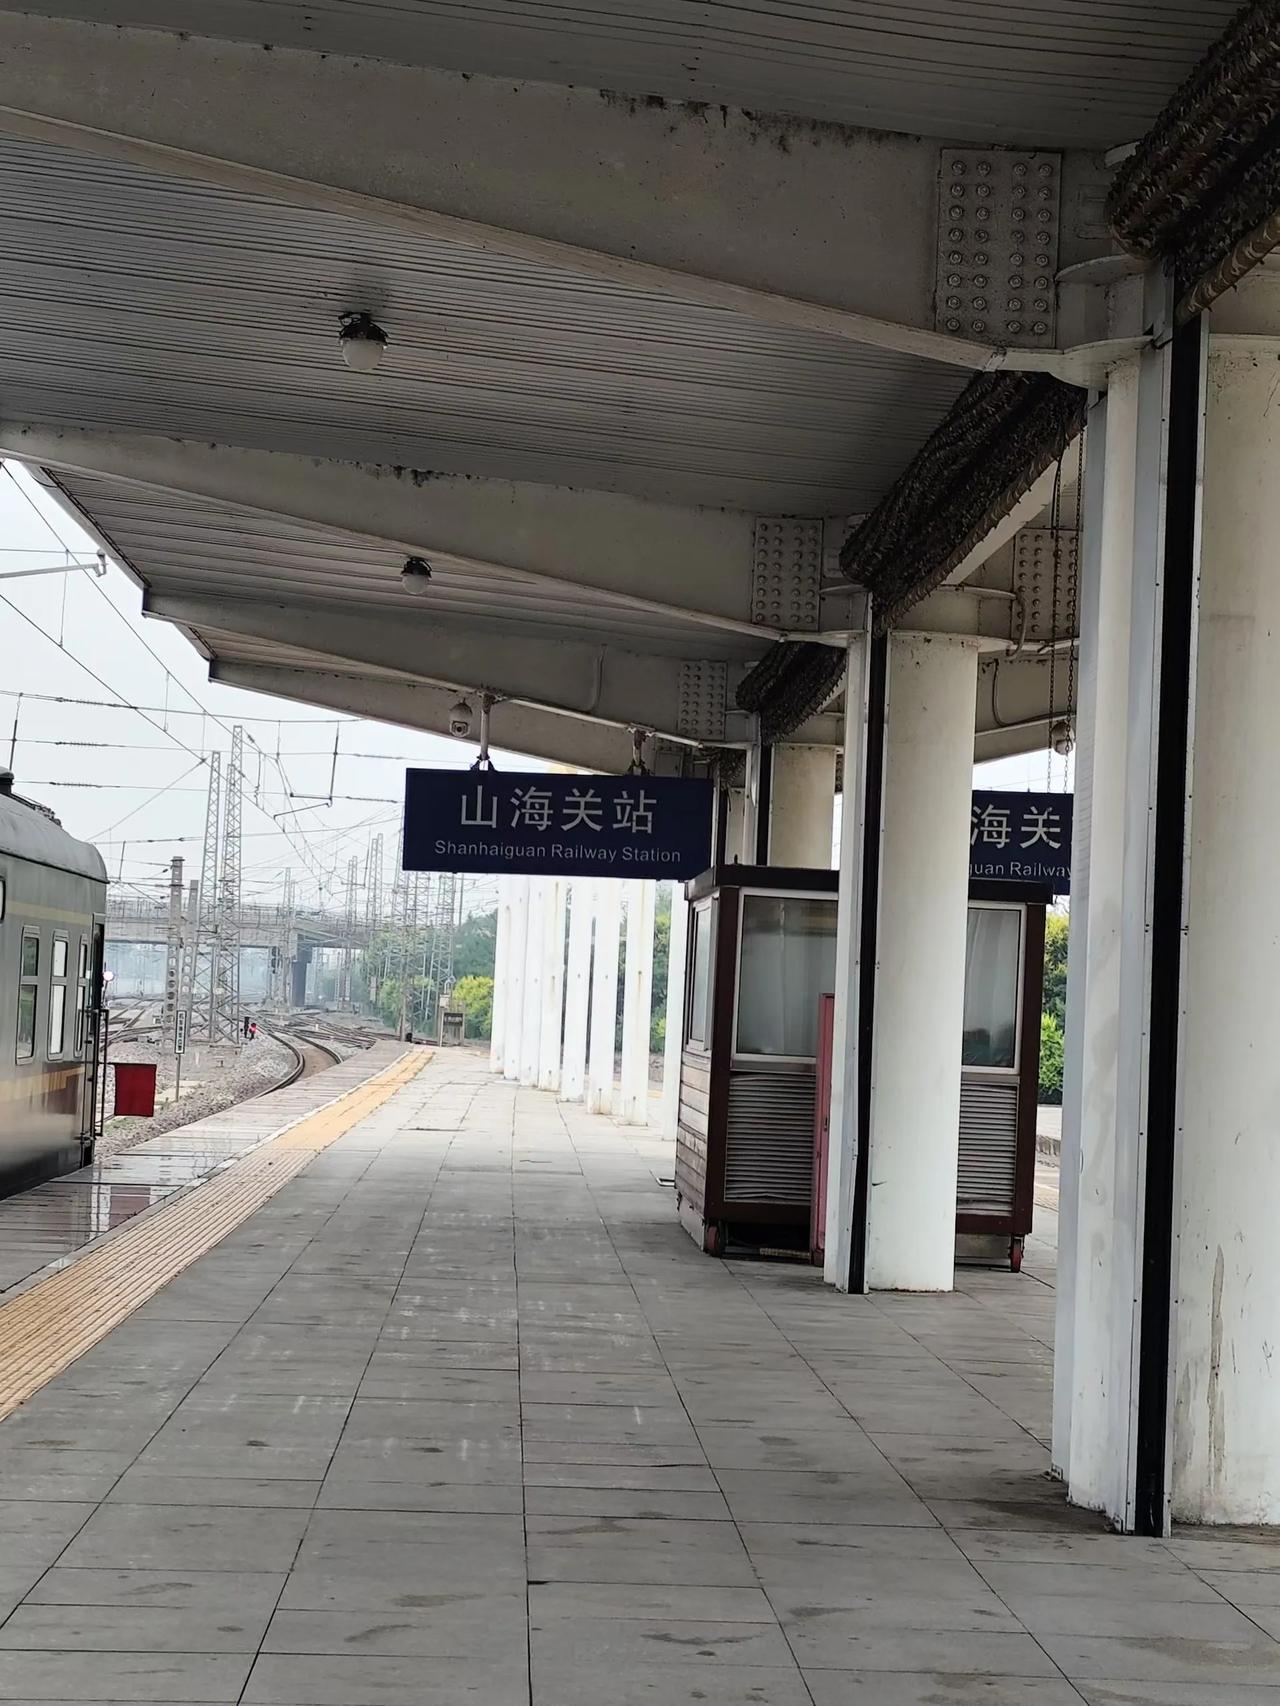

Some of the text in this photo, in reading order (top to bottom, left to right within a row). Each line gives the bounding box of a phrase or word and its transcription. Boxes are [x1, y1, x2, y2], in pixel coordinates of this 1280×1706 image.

[460, 785, 657, 834] 山海关站
[970, 804, 1062, 849] 海关
[434, 839, 681, 863] Shanhaiguan Railway Station
